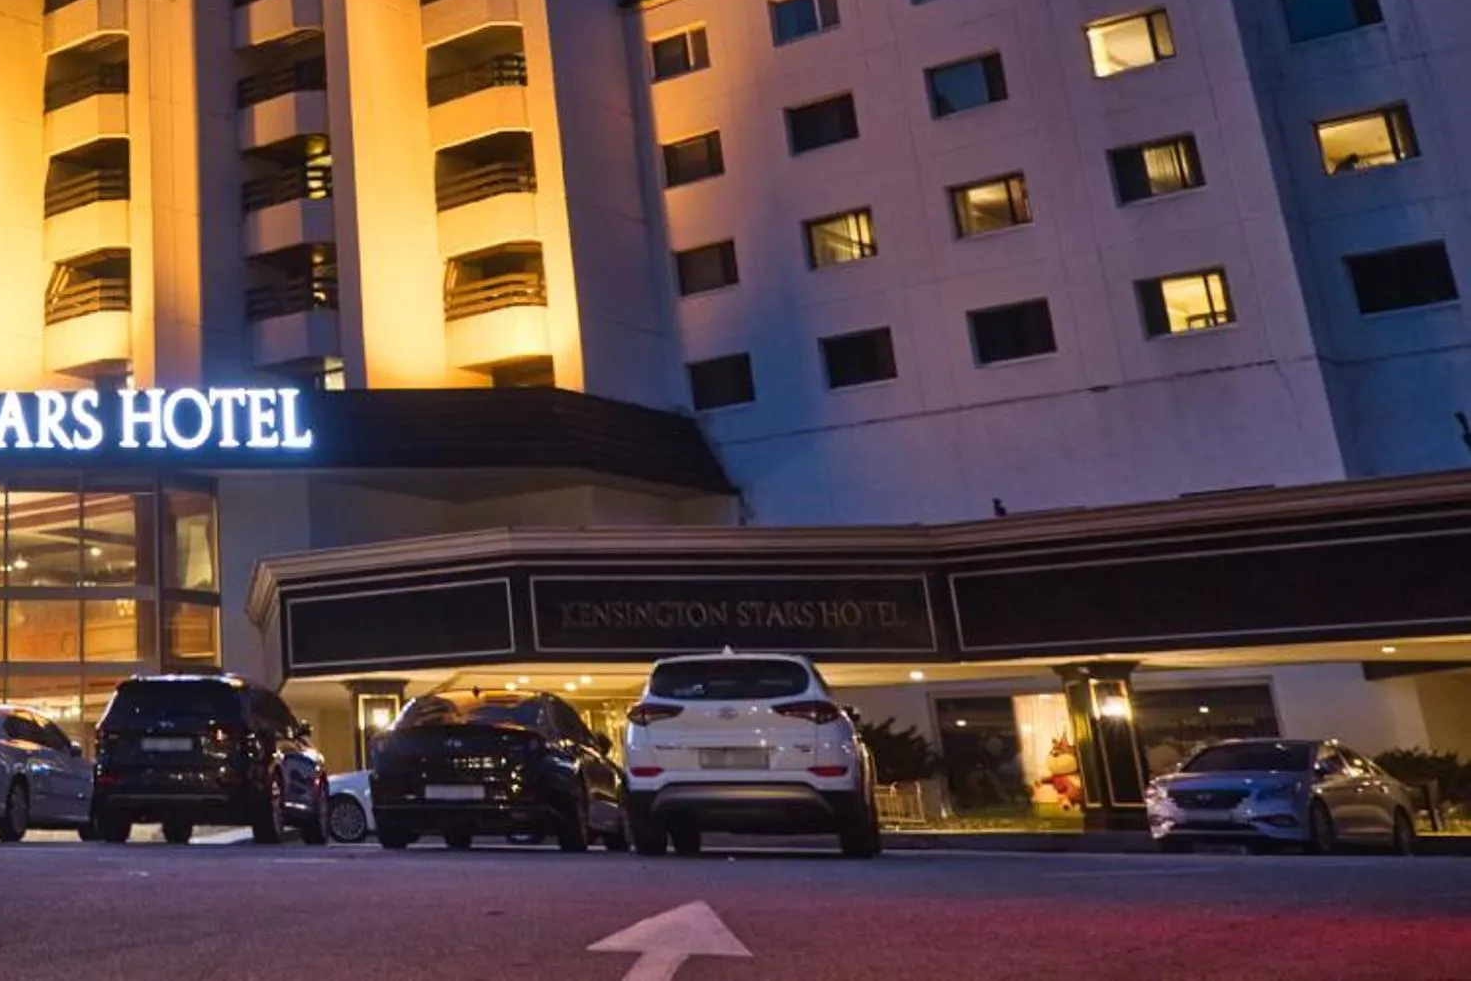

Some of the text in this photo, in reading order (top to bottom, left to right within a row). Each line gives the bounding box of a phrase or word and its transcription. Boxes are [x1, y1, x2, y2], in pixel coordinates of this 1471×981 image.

[119, 387, 313, 450] HOTEL
[559, 599, 908, 630] KENSINGTON STARS HOTEL
